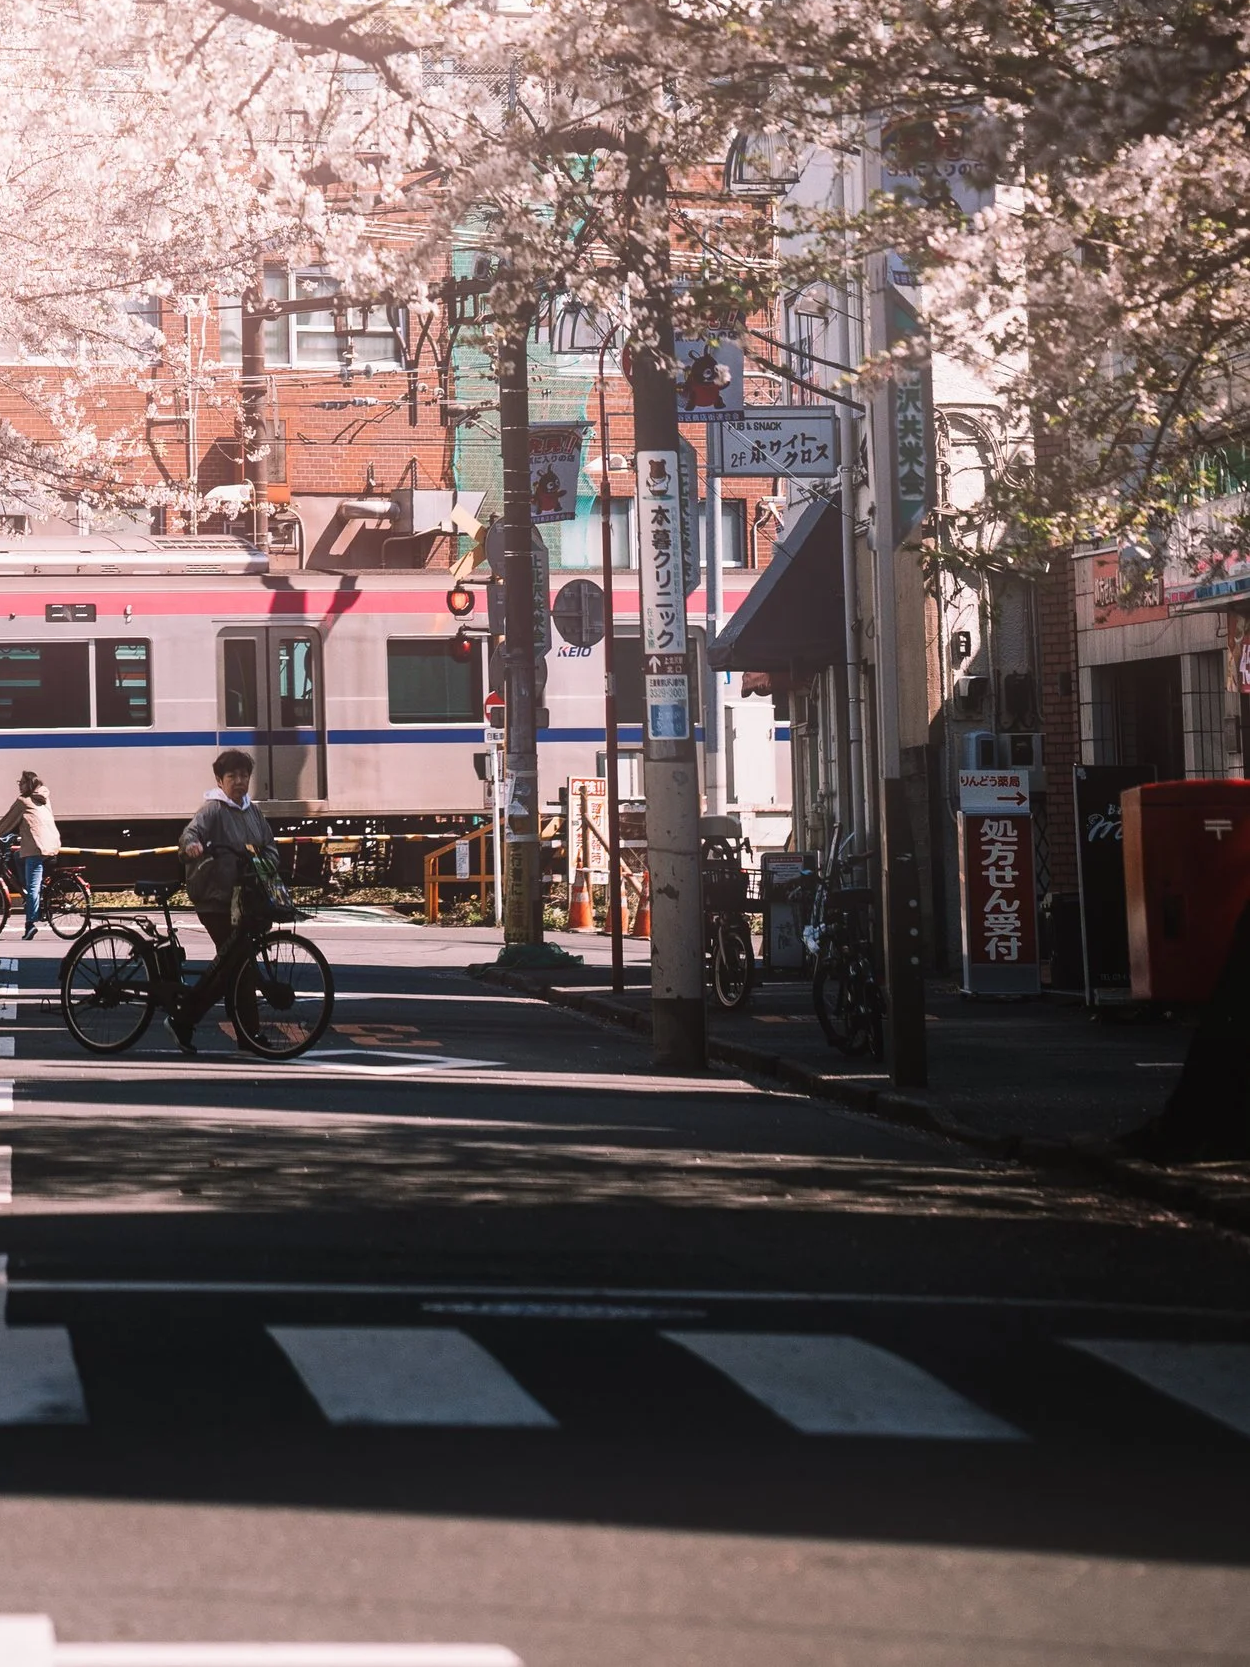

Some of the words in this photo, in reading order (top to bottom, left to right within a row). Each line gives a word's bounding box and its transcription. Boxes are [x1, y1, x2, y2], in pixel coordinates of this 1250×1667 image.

[753, 422, 782, 431] SNACK
[751, 432, 817, 464] ホワイト
[782, 443, 829, 469] クロス
[557, 646, 592, 658] KEIO
[961, 776, 1021, 788] りんどう薬局
[980, 818, 1022, 961] 処方せん受付
